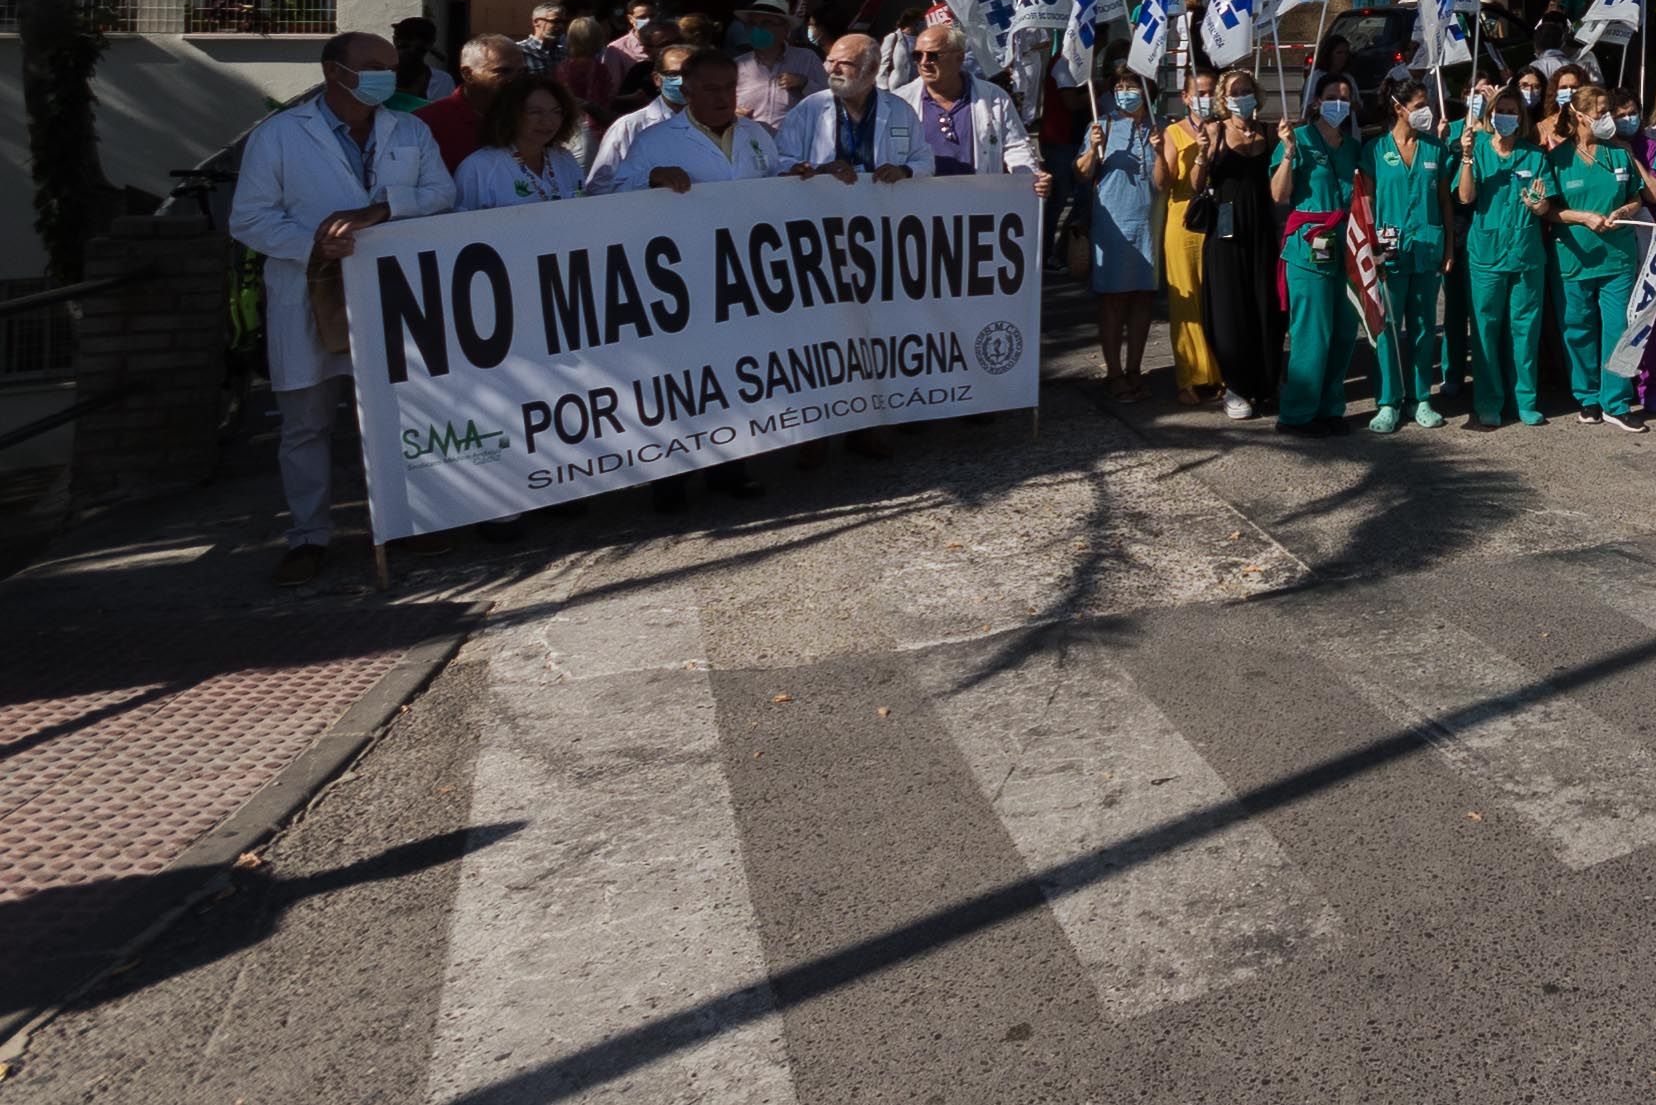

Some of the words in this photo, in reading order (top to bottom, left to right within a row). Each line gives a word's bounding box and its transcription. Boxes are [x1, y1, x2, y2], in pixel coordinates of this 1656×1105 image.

[376, 242, 514, 384] NO
[537, 236, 690, 355] MAS
[715, 212, 1025, 323] AGRESIONES
[521, 387, 626, 454] POR
[632, 365, 730, 427] UNA
[735, 337, 873, 404] SANIDAD
[873, 331, 969, 380] DIGNA
[527, 425, 737, 489] SINDICATO
[749, 396, 867, 437] MÉDICO
[887, 384, 973, 409] CÁDIZ
